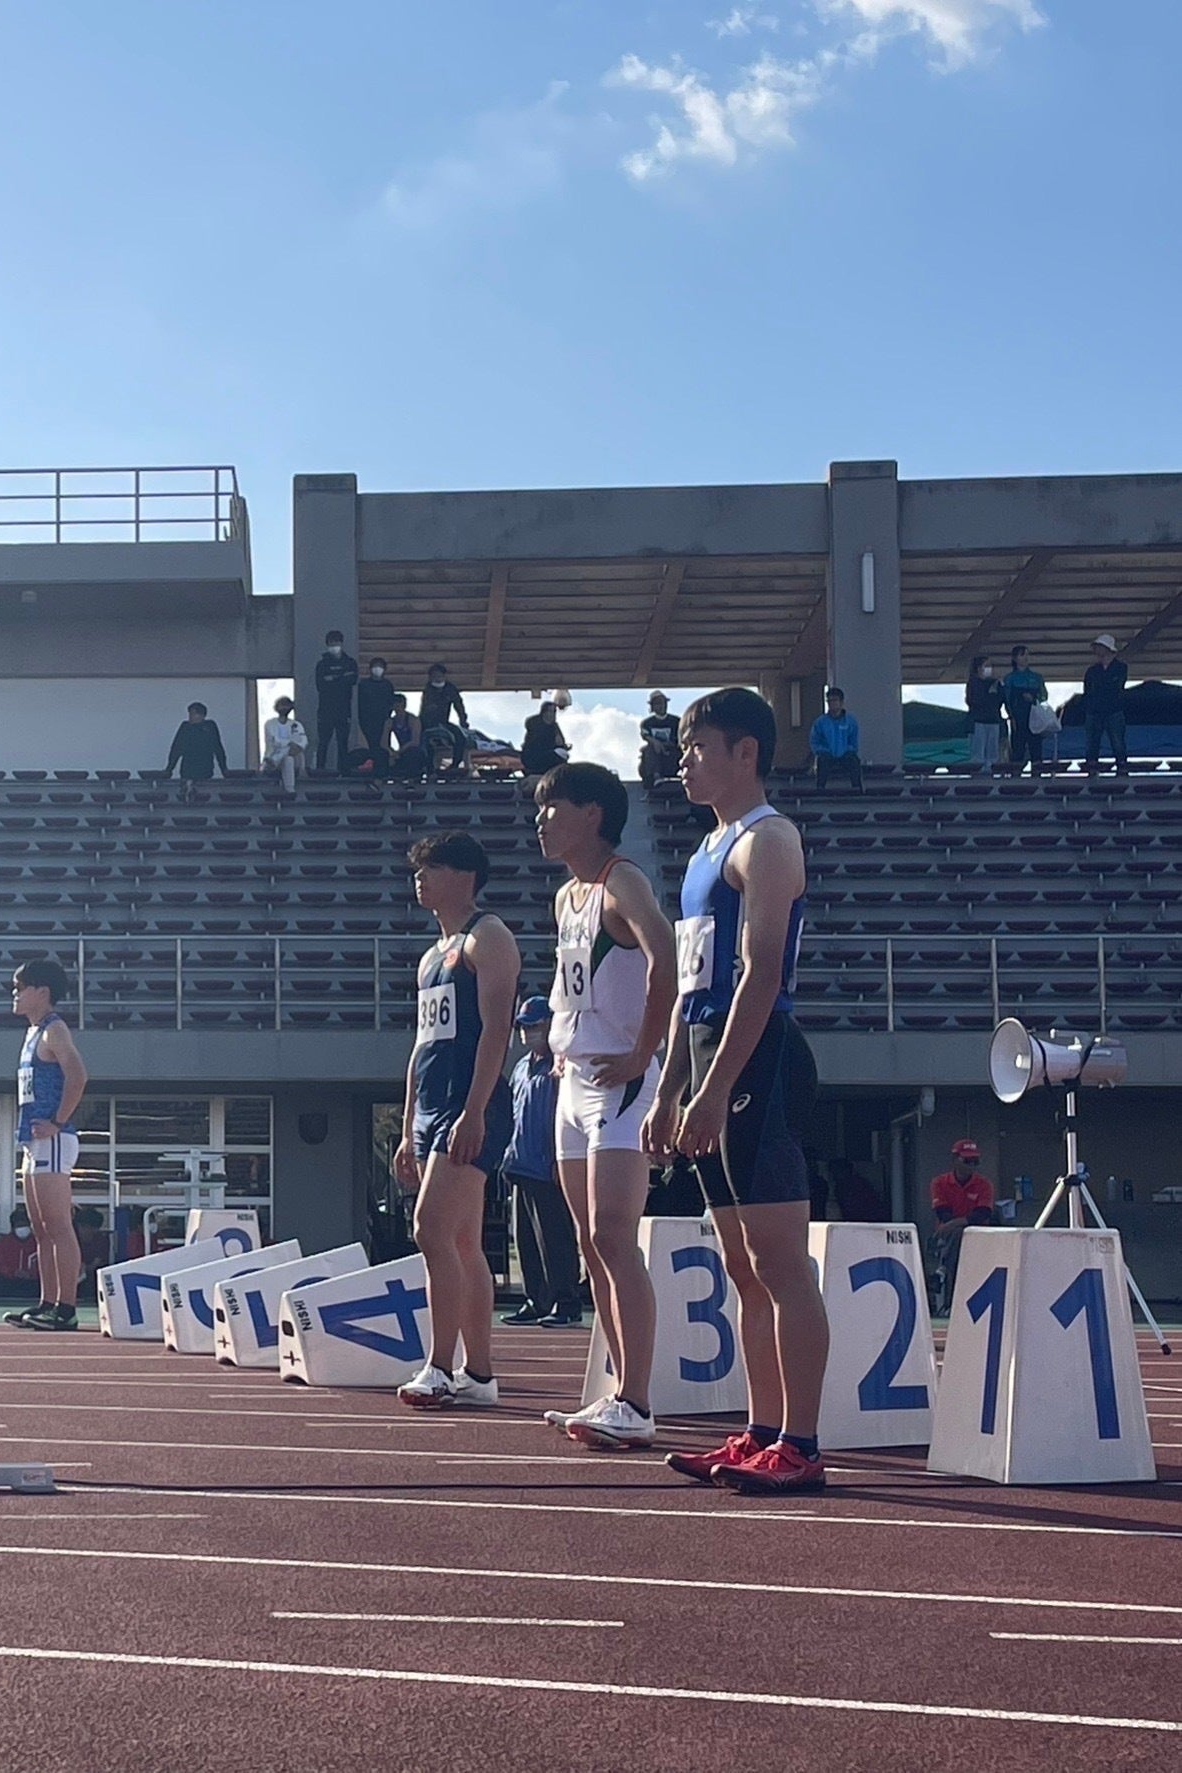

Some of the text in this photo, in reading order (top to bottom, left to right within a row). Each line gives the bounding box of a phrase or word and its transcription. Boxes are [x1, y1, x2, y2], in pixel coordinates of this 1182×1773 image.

[420, 995, 450, 1030] 396
[886, 1230, 913, 1244] NISHI
[294, 1300, 314, 1332] NISHI
[317, 1279, 429, 1362] 4
[671, 1246, 735, 1382] 3
[848, 1256, 930, 1411] 2
[966, 1266, 1008, 1435] 1
[1049, 1268, 1121, 1439] 1
